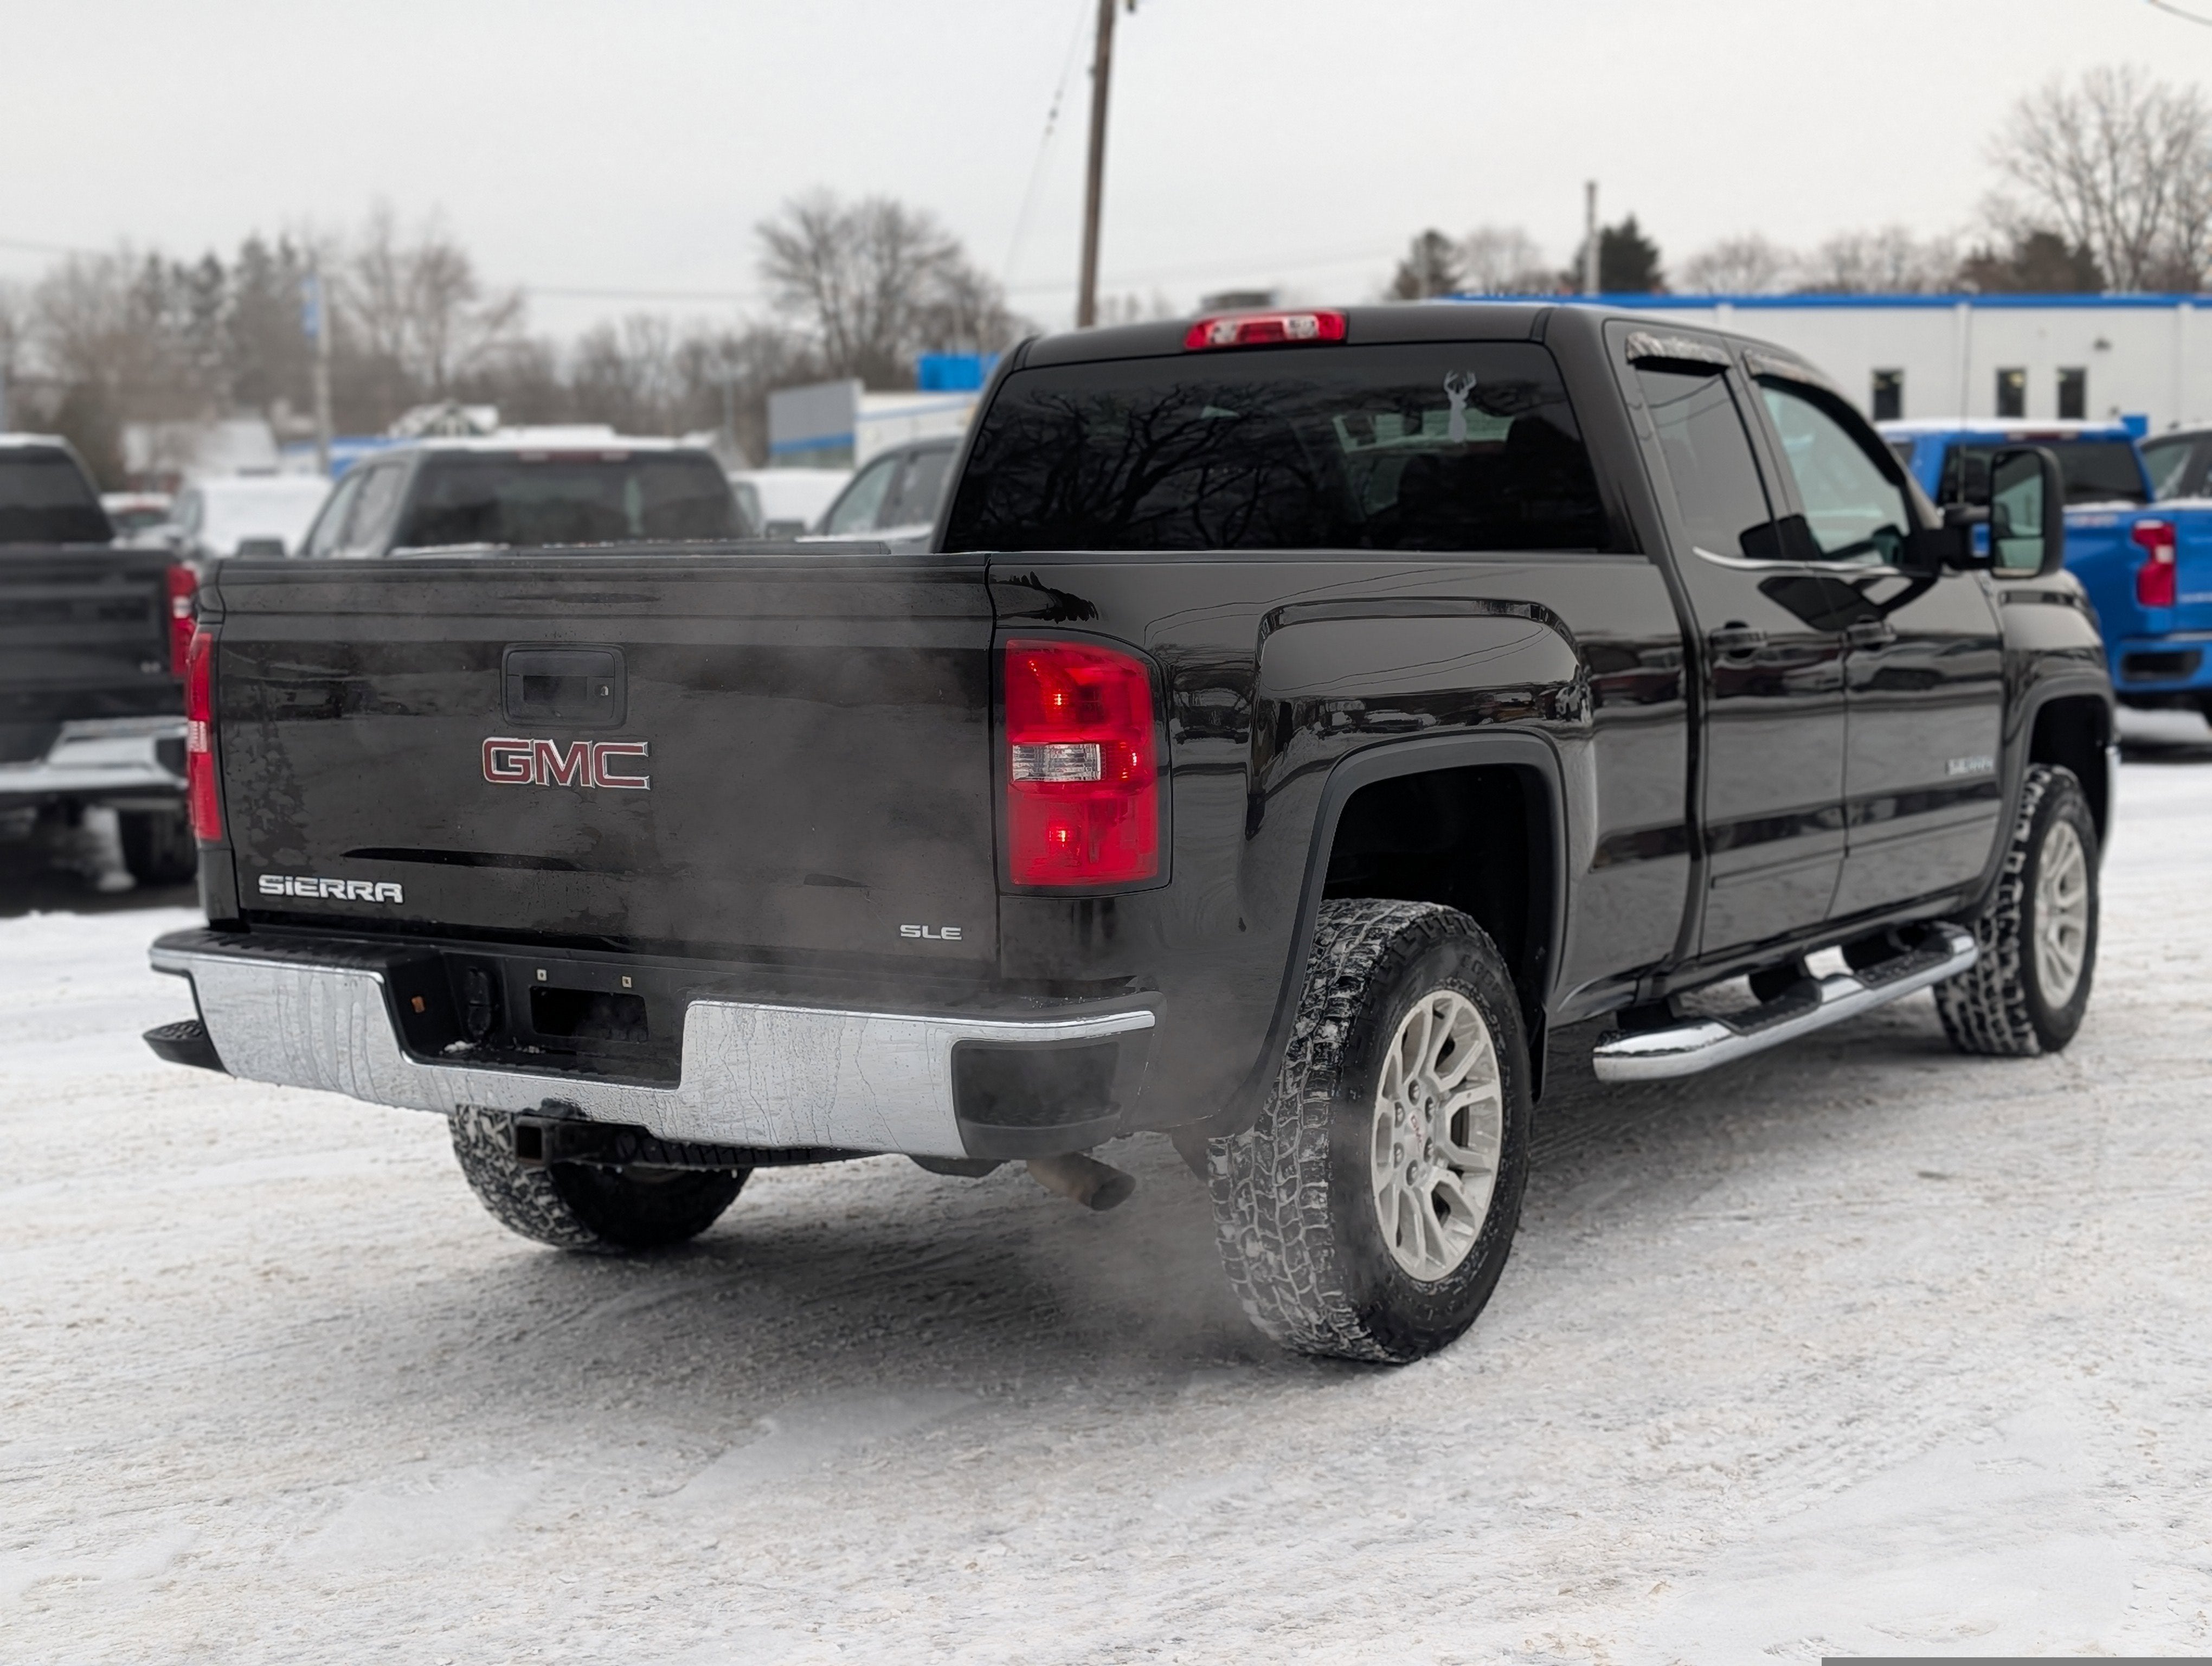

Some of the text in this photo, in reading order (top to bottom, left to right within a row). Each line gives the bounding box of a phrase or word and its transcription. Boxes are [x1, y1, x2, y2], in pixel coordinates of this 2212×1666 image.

[483, 736, 651, 790] GMC
[259, 874, 403, 904] SIERRA
[900, 924, 962, 940] SLE
